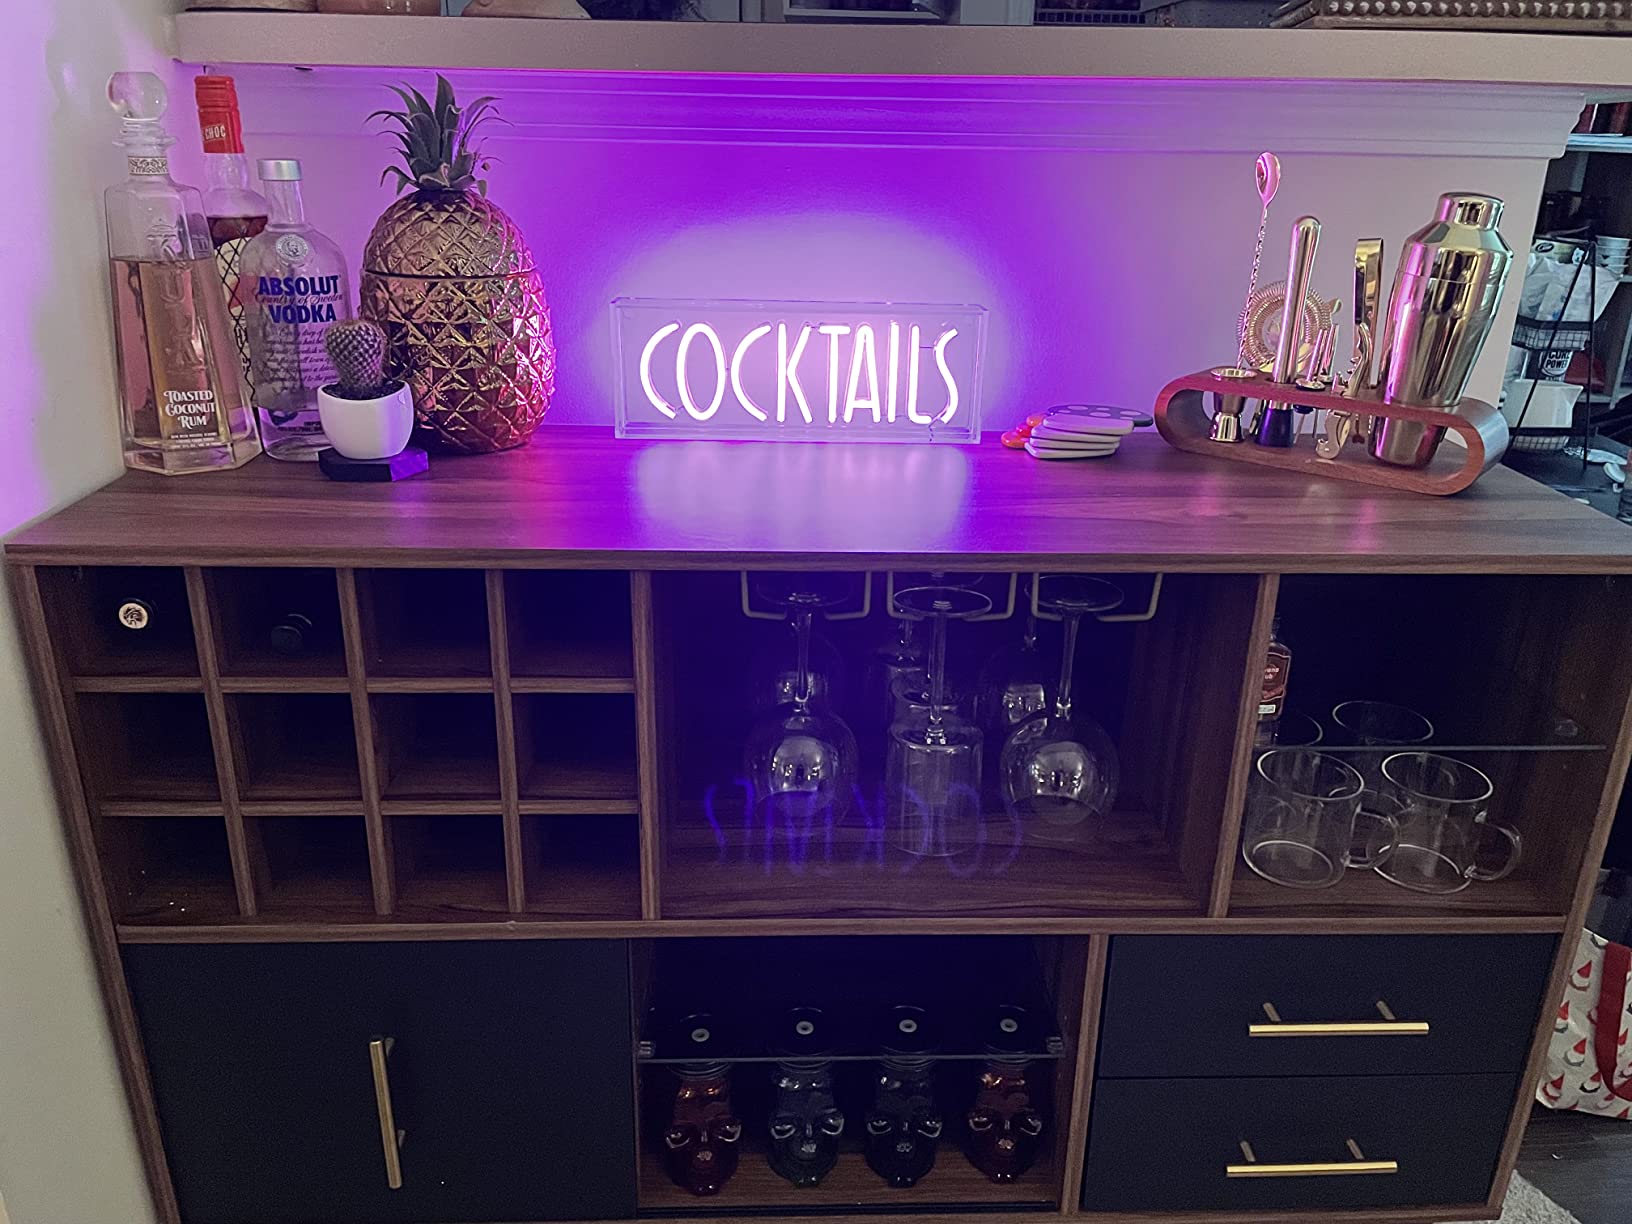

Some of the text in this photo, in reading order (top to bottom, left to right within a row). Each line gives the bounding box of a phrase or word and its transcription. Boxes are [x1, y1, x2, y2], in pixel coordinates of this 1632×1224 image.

[204, 125, 226, 140] CHOC
[258, 275, 339, 296] ABSOLUT
[297, 293, 310, 307] of
[310, 293, 343, 305] Sweden
[268, 304, 337, 324] VODKA
[640, 322, 959, 425] COCKTAILS
[163, 390, 213, 404] TOASTED
[165, 402, 216, 416] COCONUT
[177, 415, 207, 429] RUM
